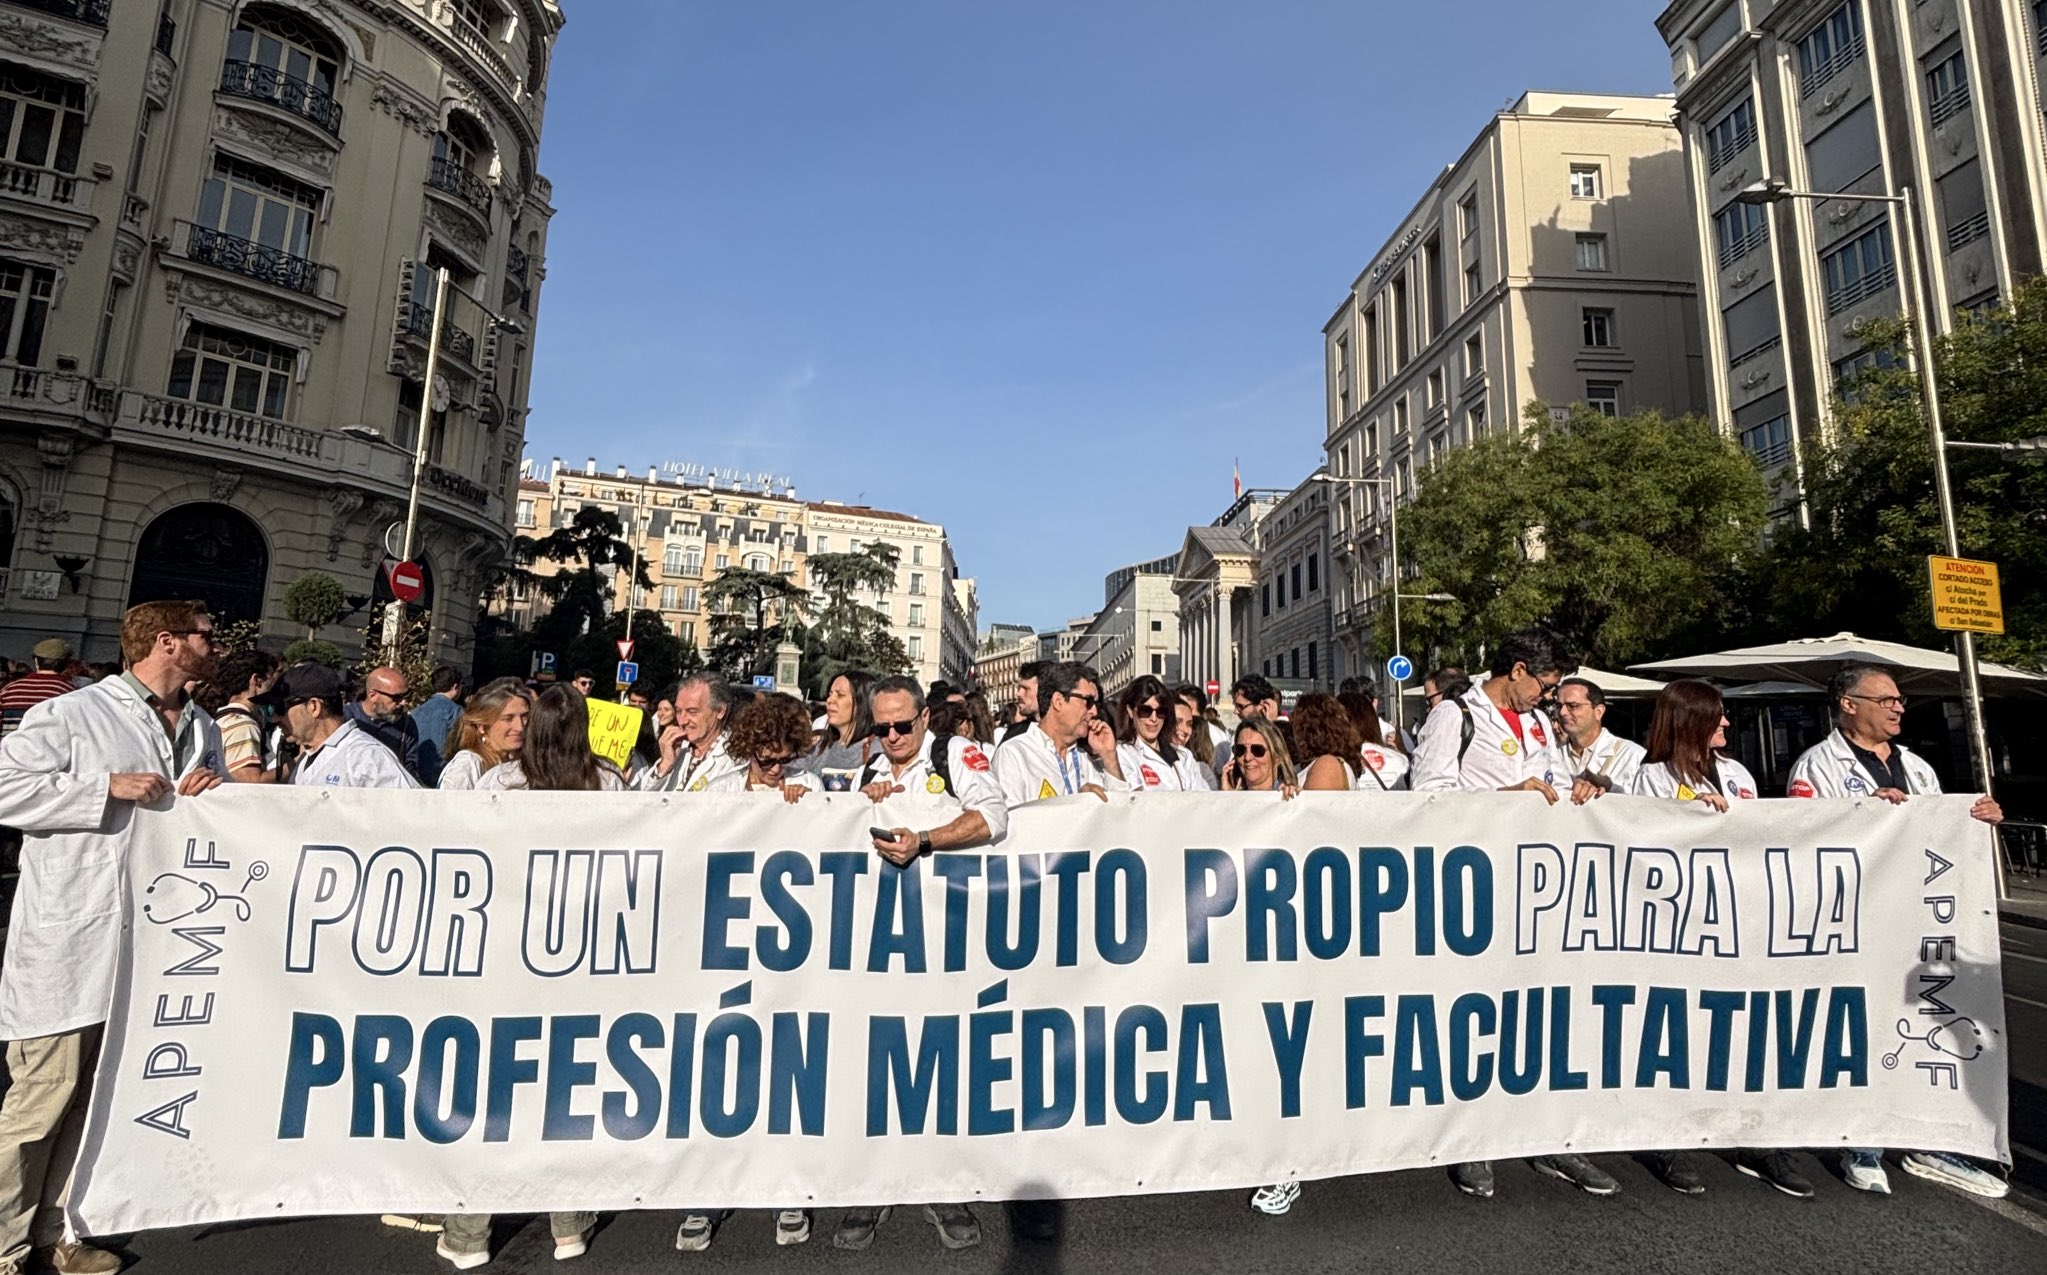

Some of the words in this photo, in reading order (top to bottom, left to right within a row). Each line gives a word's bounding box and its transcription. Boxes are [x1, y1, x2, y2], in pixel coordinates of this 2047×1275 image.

[663, 461, 704, 476] HOTEL
[713, 466, 751, 483] VILLA
[1938, 573, 1969, 584] CORTADO
[541, 652, 555, 670] P
[606, 712, 629, 732] UN
[285, 845, 493, 976] POR
[520, 849, 663, 977] UN
[700, 847, 1148, 974] ESTATUTO
[1183, 846, 1494, 965] PROPIO
[1515, 842, 1739, 958] PARA
[1765, 847, 1861, 958] LA
[277, 980, 830, 1144] PROFESIÓN
[866, 978, 1232, 1137] MÉDICA
[1262, 999, 1314, 1119] Y
[1343, 984, 1869, 1110] FACULTATIVA
